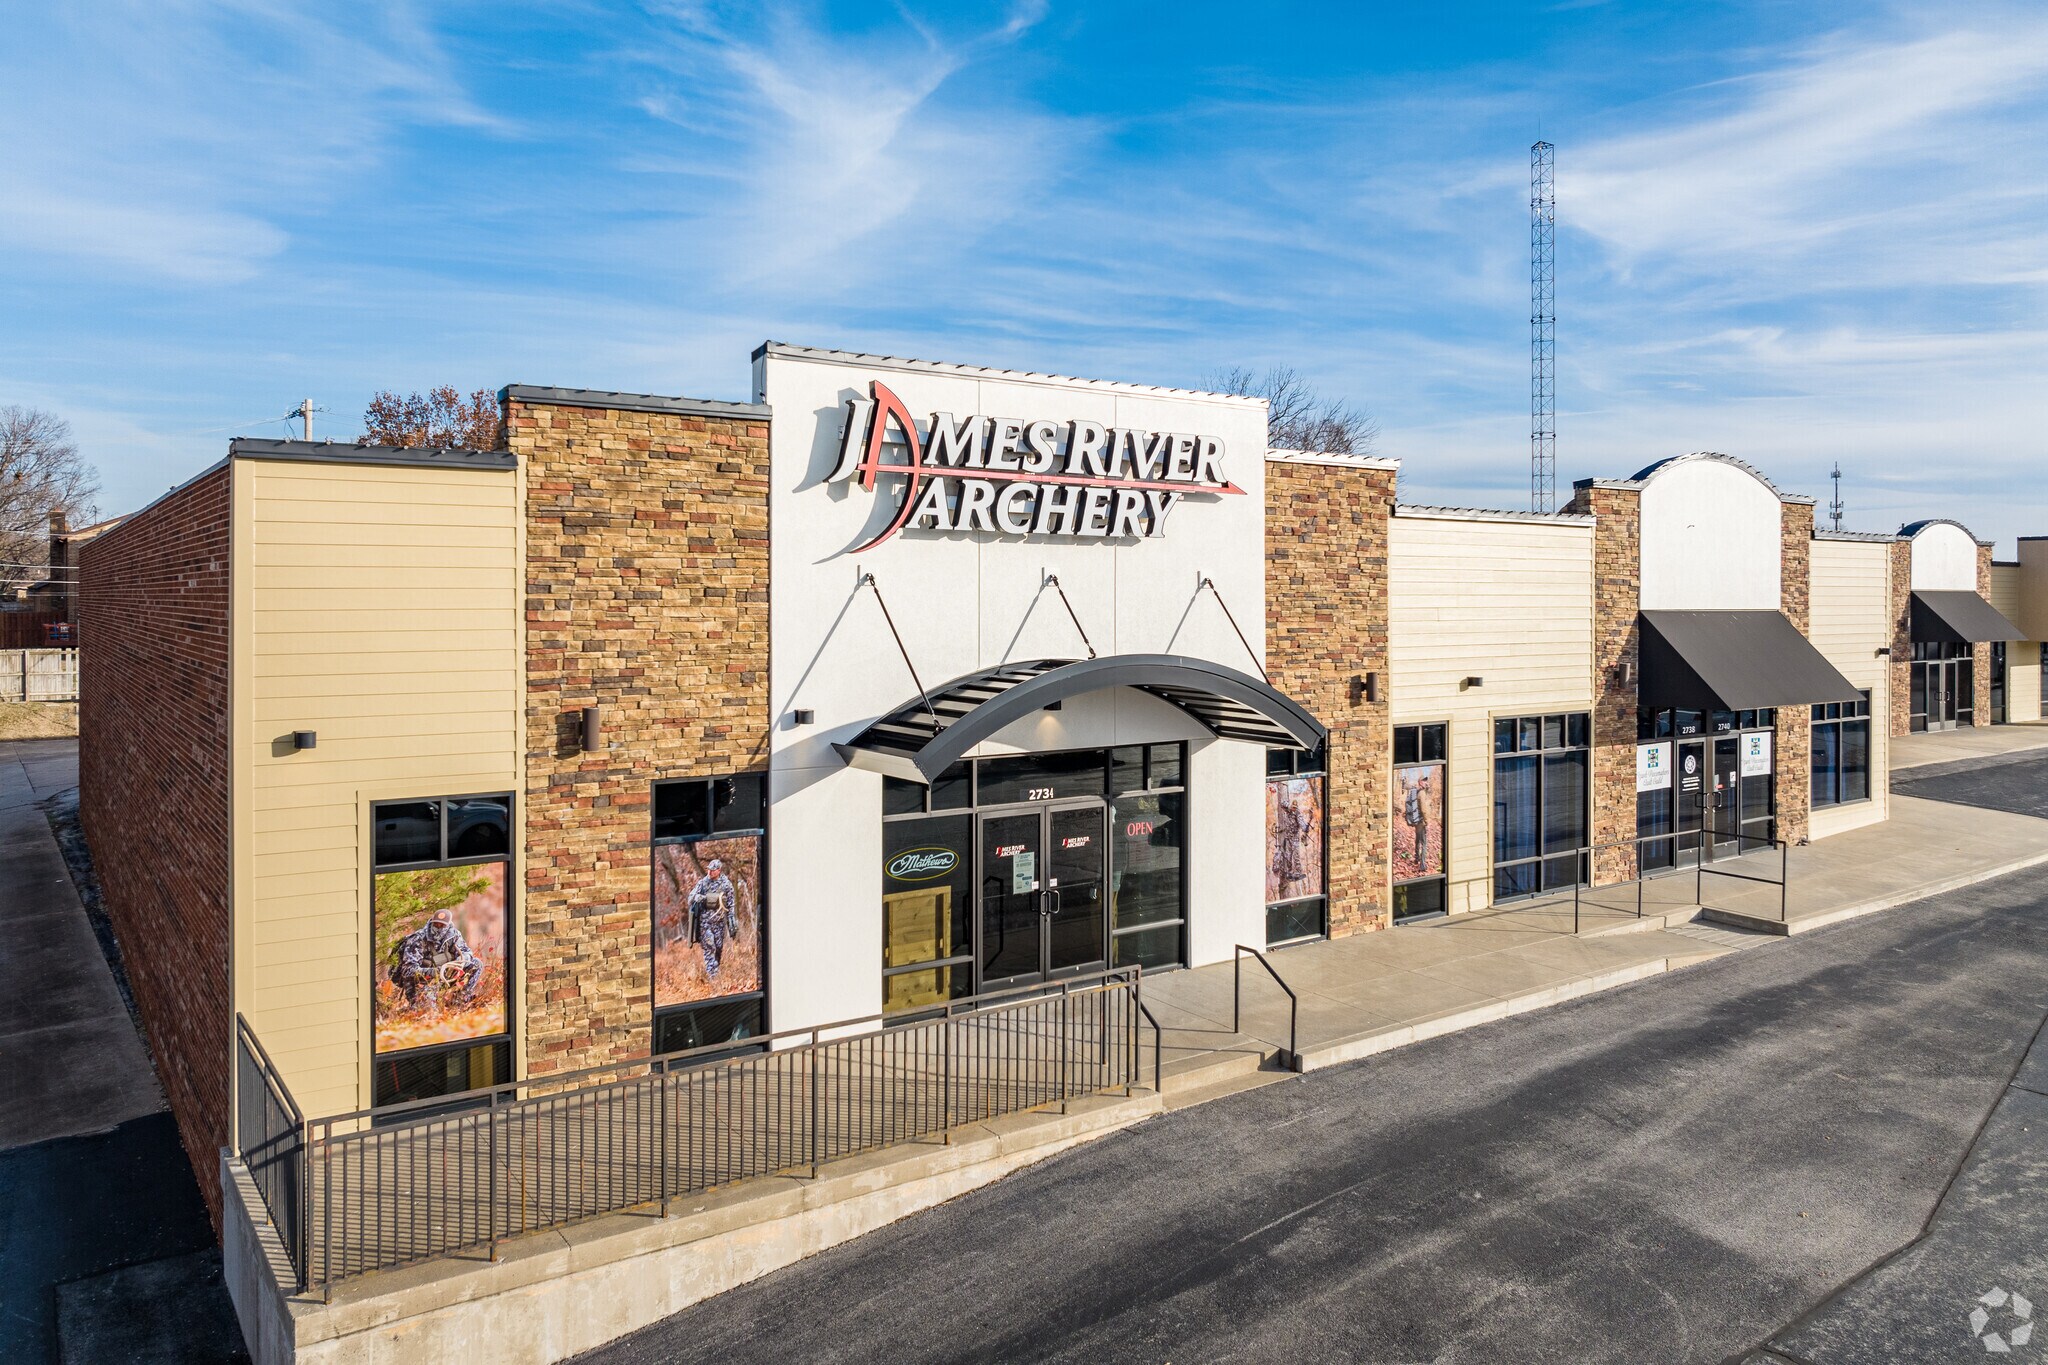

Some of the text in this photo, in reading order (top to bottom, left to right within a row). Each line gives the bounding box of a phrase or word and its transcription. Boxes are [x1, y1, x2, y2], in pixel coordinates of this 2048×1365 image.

[823, 380, 1228, 492] JAMES RIVER
[903, 476, 1184, 539] ARCHERY
[1682, 725, 1696, 734] 2738
[1718, 722, 1731, 731] 2740
[1127, 822, 1153, 837] OPEN
[890, 852, 955, 877] Mathews
